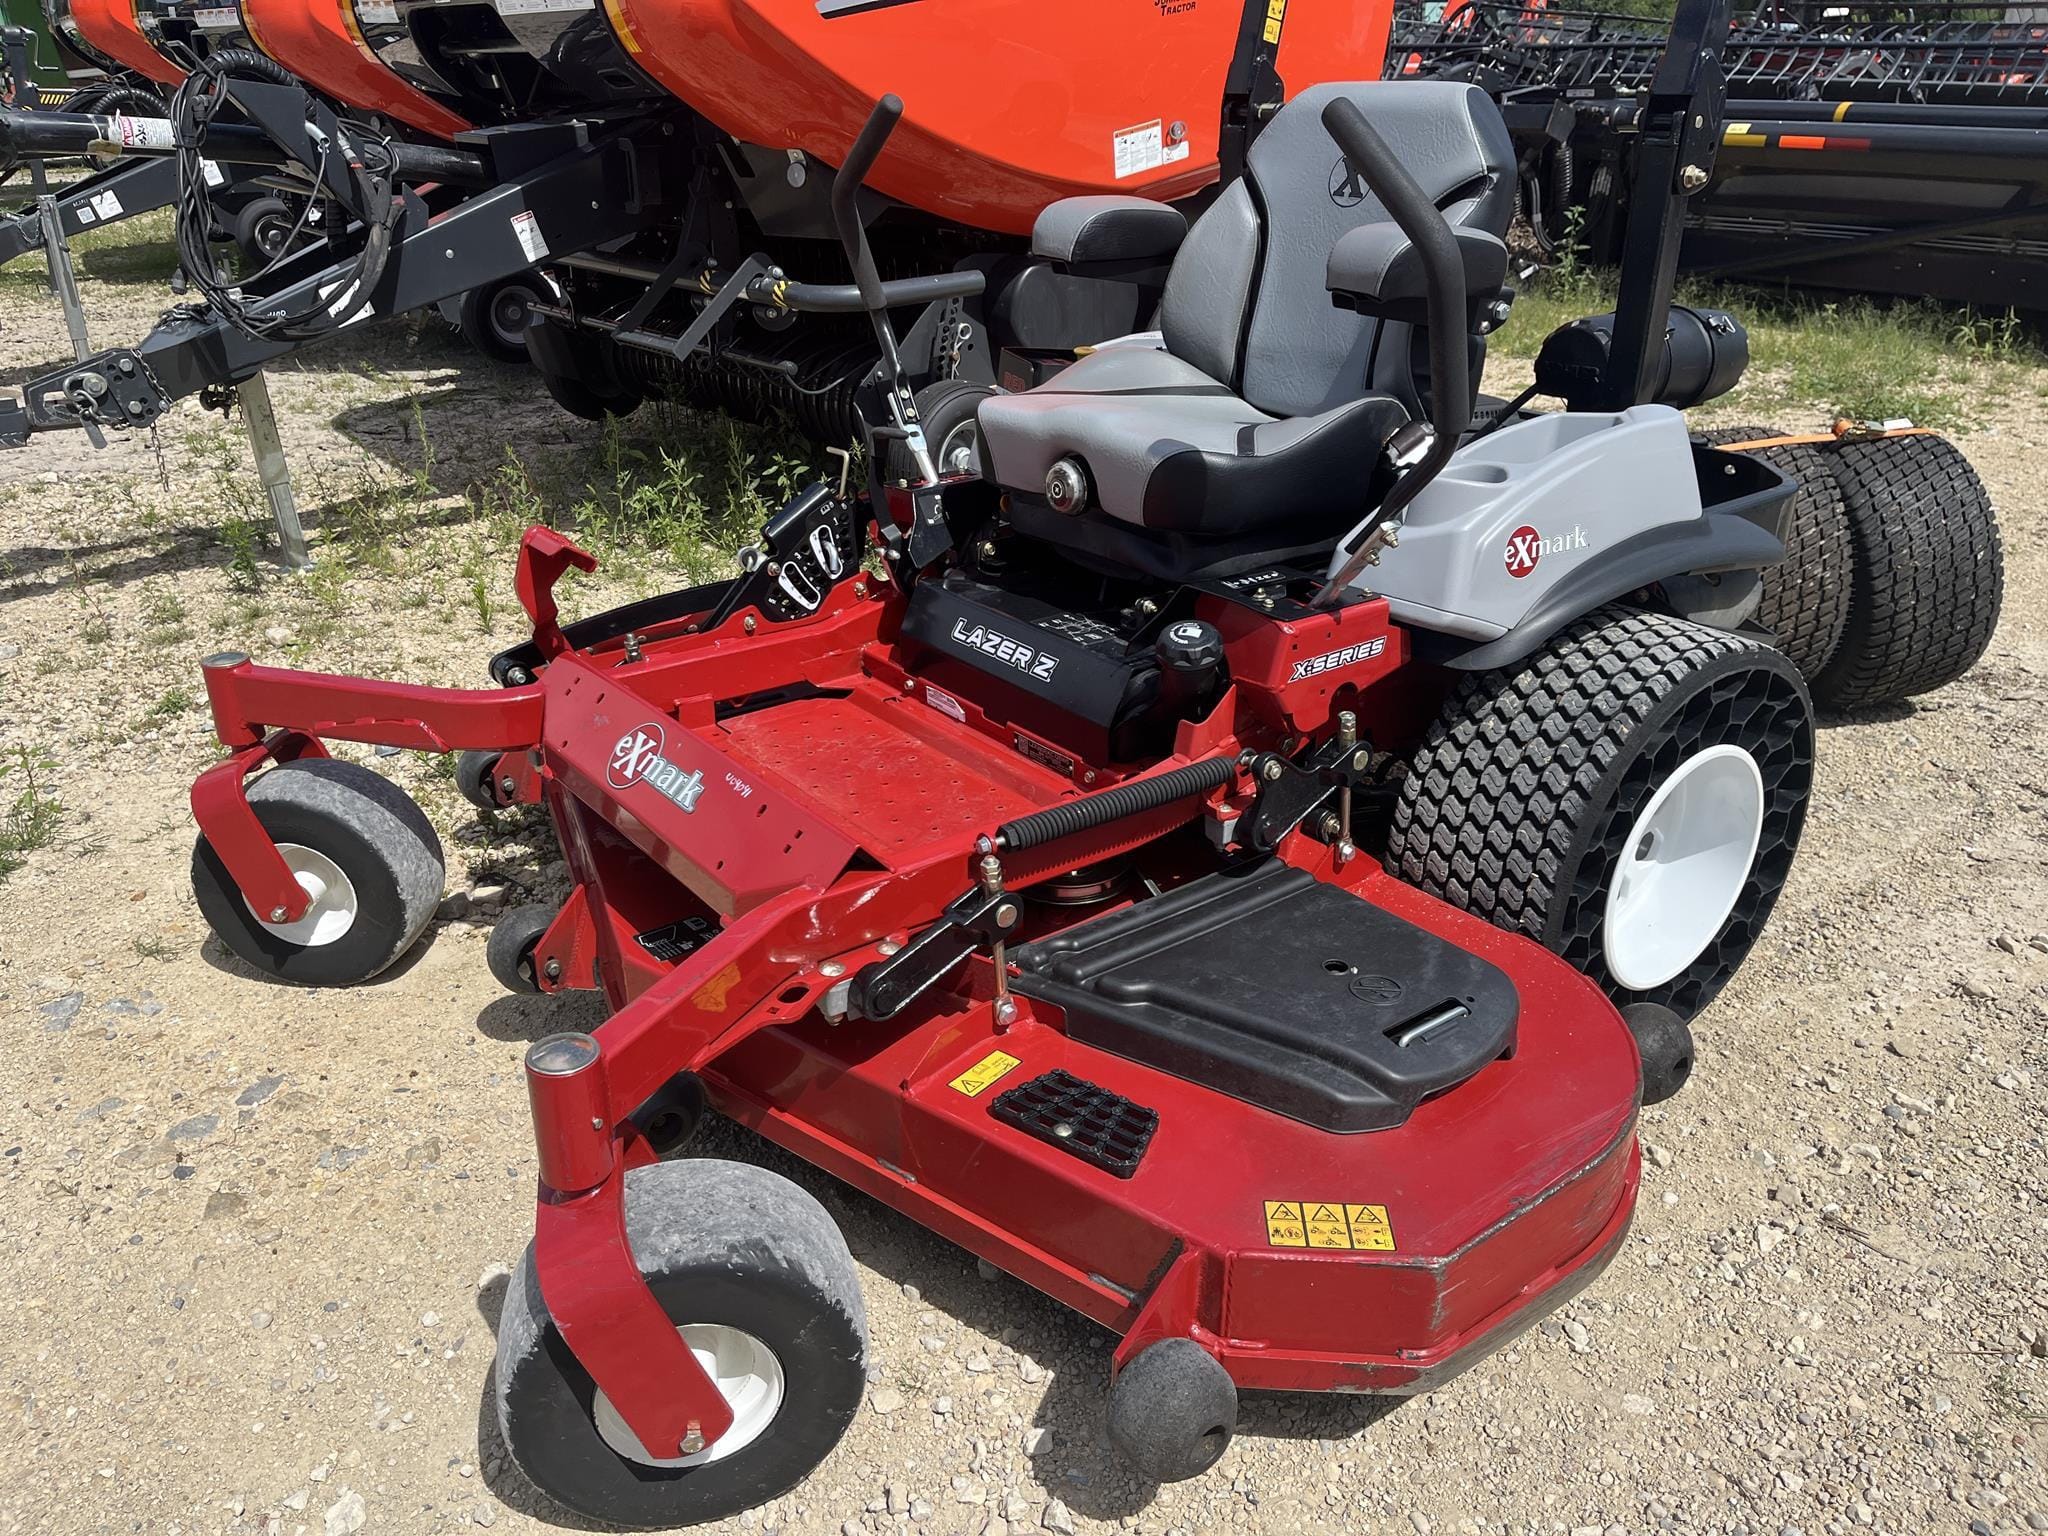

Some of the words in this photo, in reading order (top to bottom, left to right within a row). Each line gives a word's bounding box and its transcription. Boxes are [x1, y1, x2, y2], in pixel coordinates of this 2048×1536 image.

[1160, 2, 1196, 16] TRACTOR
[1503, 523, 1587, 571] eXmark
[951, 617, 1035, 673] LAZER
[1029, 652, 1060, 683] Z
[1287, 635, 1387, 684] X-SERIES
[610, 730, 706, 812] eXmark
